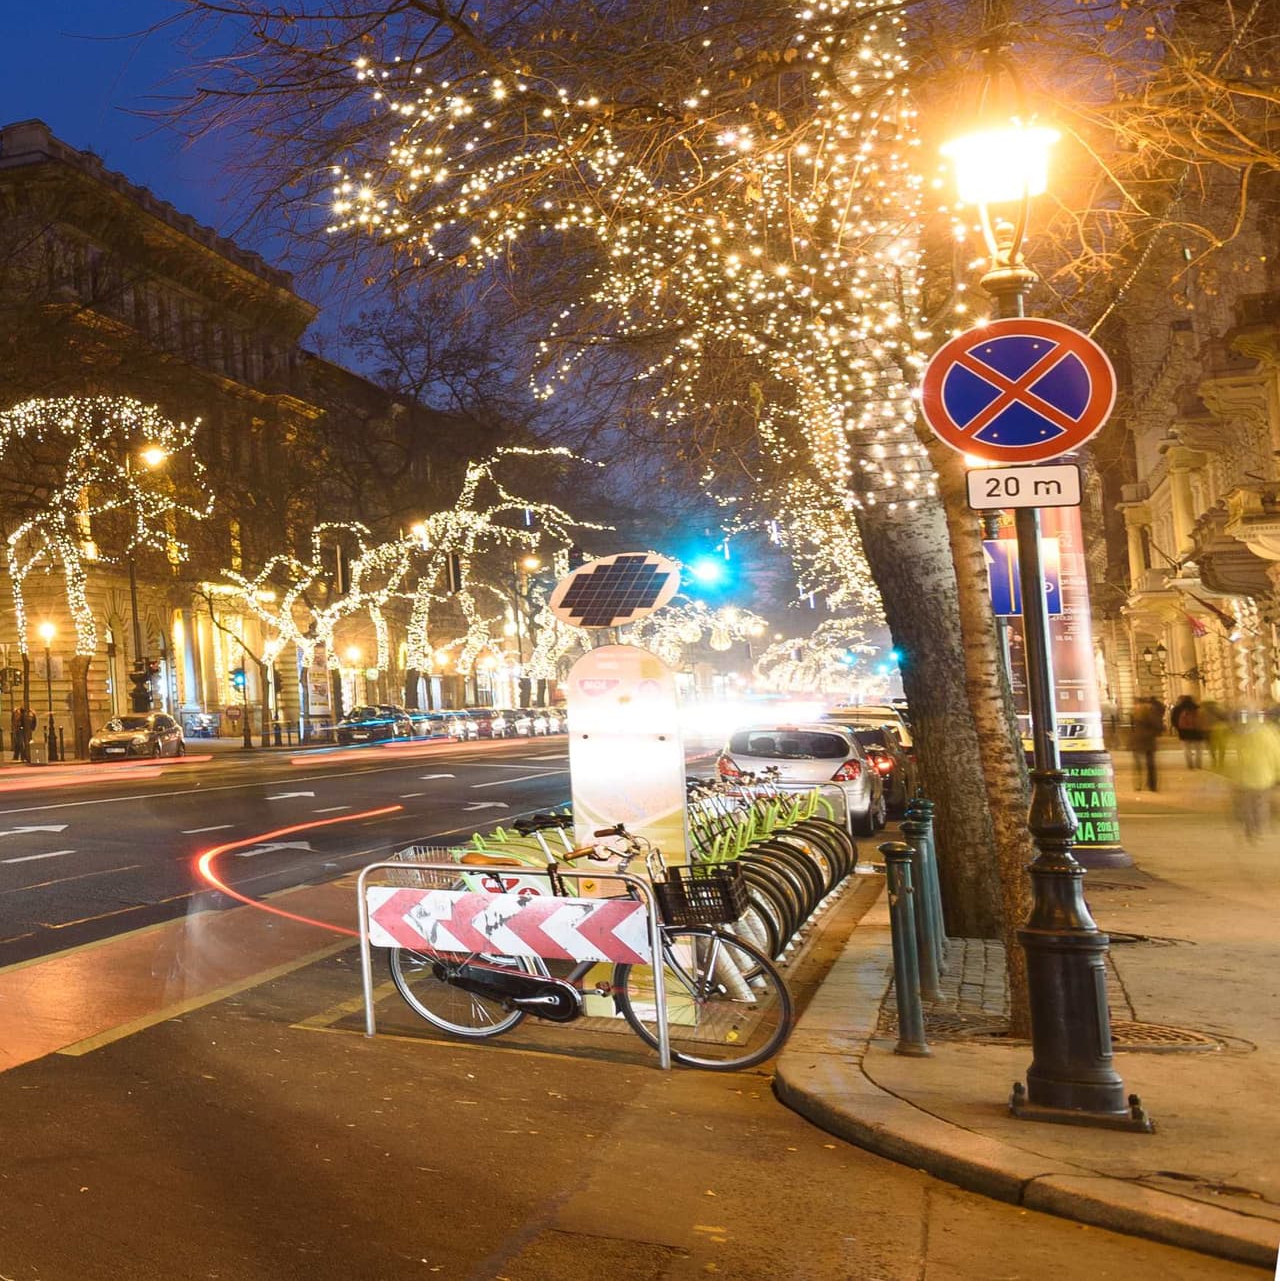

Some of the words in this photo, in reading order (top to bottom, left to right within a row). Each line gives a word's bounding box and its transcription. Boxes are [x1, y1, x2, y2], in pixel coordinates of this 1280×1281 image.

[985, 476, 1020, 498] 20
[1033, 479, 1062, 496] m
[1091, 791, 1100, 807] A
